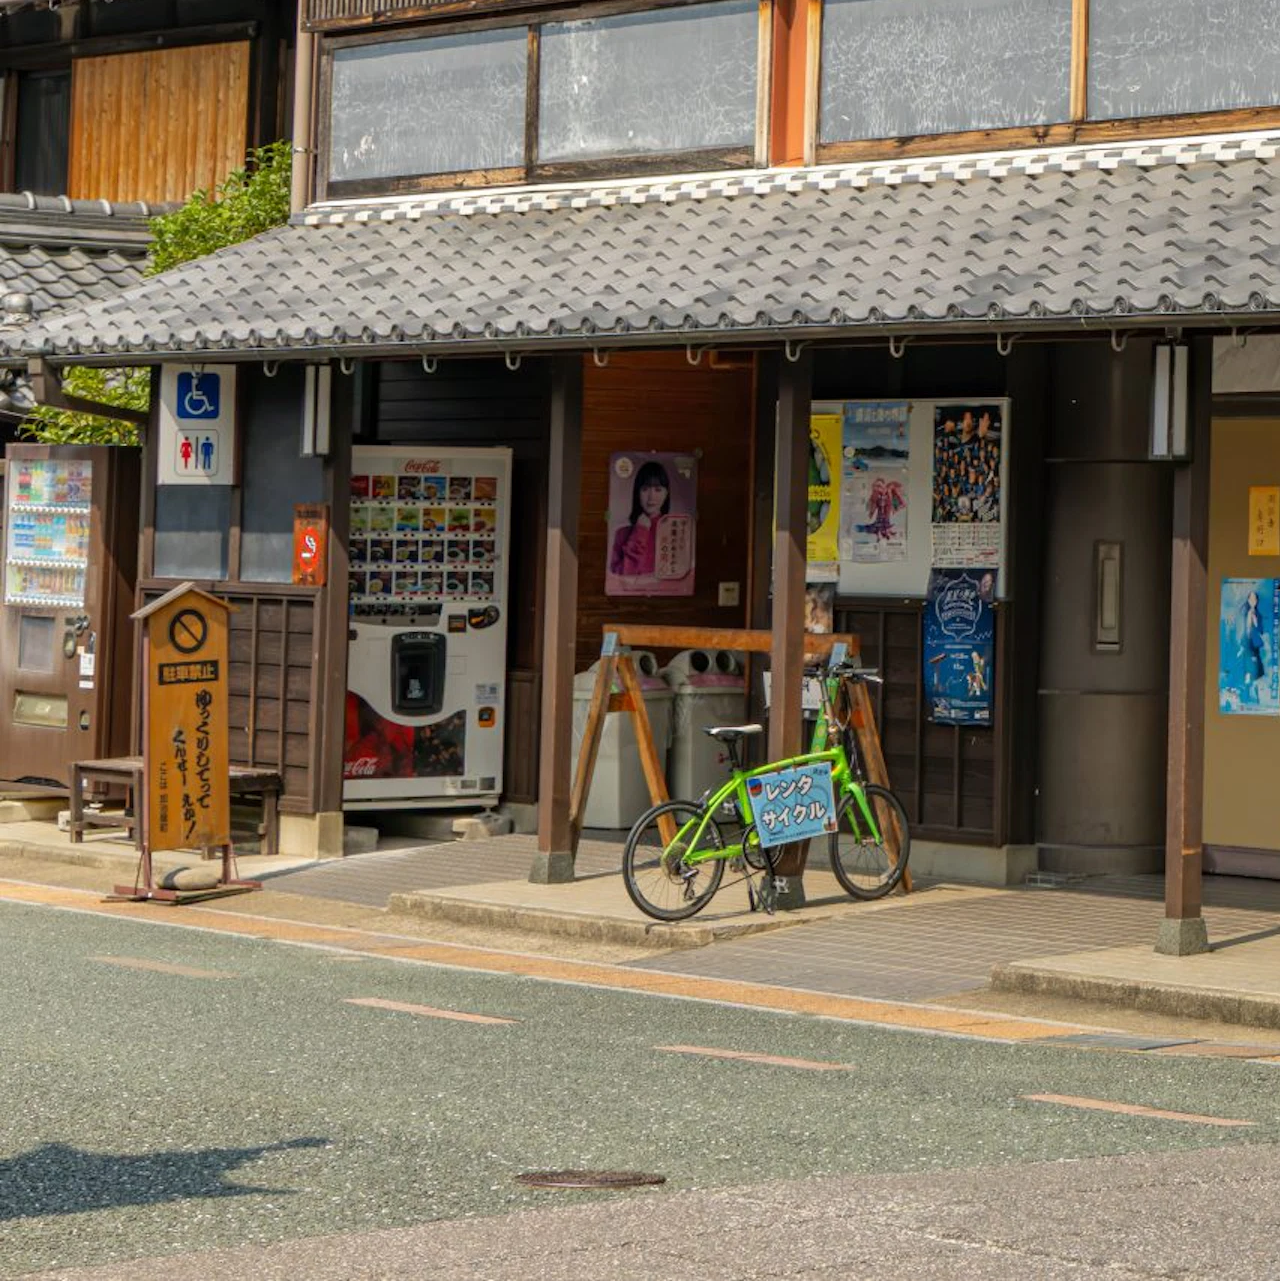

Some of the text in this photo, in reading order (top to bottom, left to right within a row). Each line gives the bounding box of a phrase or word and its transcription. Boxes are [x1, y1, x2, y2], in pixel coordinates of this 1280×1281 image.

[404, 459, 441, 473] Coca-Cola
[765, 775, 813, 801] レンタ
[762, 801, 826, 831] サイクル
